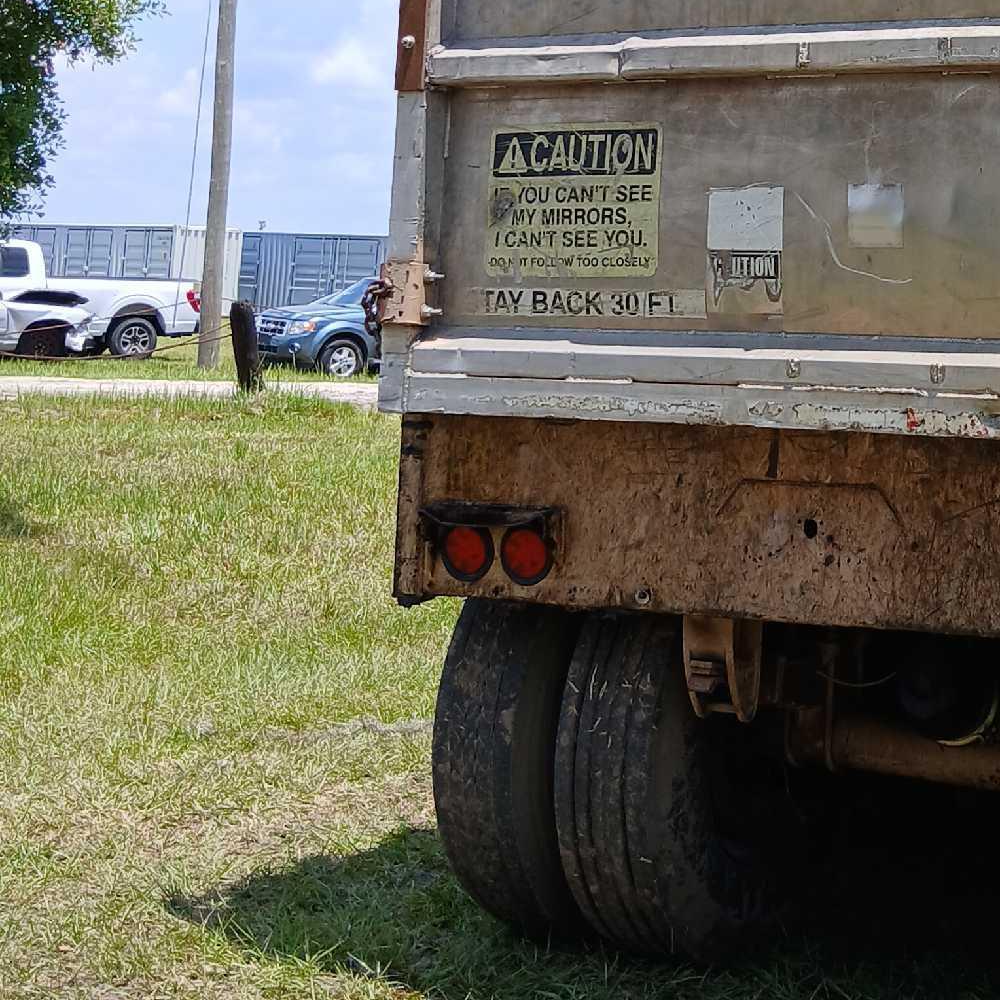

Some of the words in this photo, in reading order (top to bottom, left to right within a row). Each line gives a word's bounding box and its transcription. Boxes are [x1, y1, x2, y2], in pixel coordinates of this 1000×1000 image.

[529, 132, 654, 173] CAUTION
[517, 186, 549, 203] YOU
[555, 184, 609, 203] CAN'T
[616, 184, 653, 202] SEE
[511, 208, 537, 226] MY
[541, 207, 632, 228] MIRRORS,
[494, 231, 500, 247] I
[504, 230, 557, 248] CAN'T
[562, 230, 598, 247] SEE
[605, 229, 648, 248] YOU.
[577, 257, 599, 267] TOO
[713, 256, 775, 278] CUTION
[532, 290, 603, 316] BACK
[611, 291, 640, 316] 30
